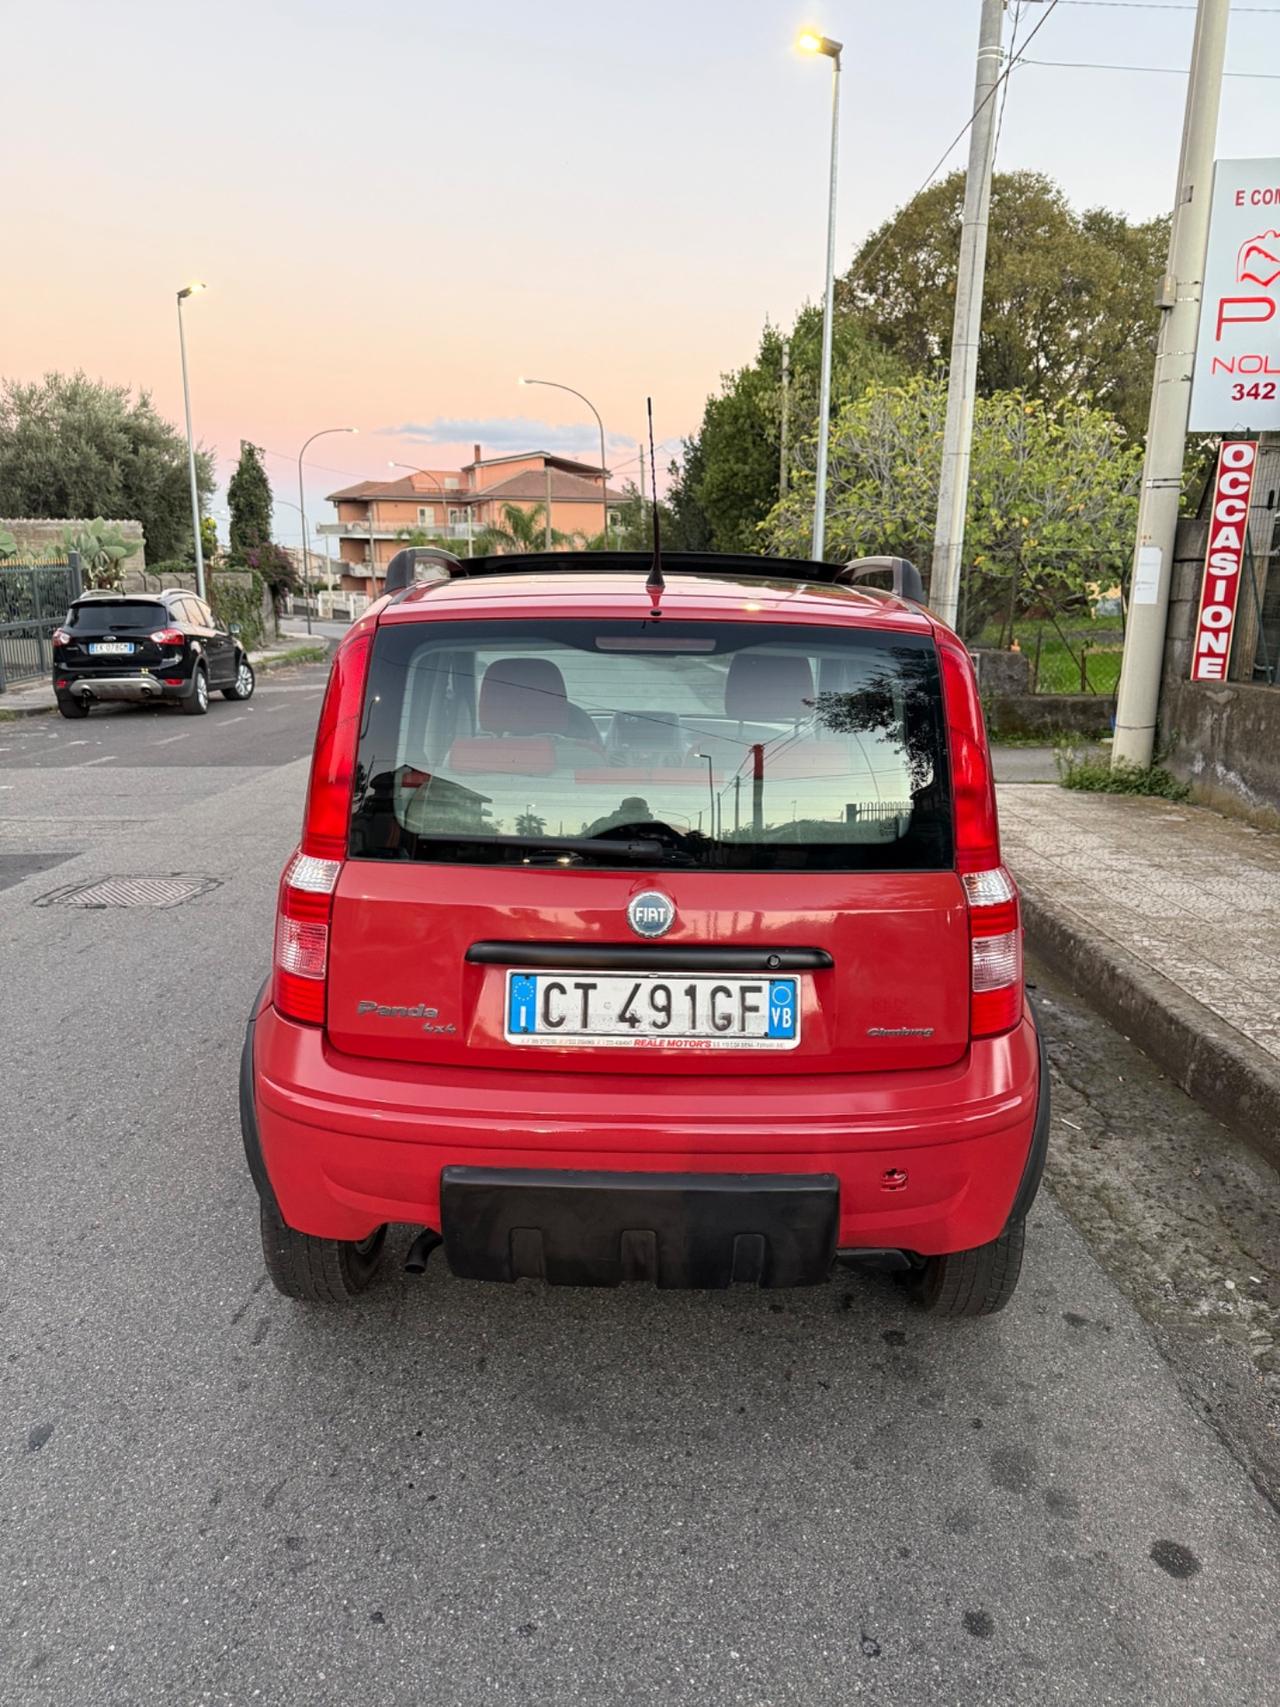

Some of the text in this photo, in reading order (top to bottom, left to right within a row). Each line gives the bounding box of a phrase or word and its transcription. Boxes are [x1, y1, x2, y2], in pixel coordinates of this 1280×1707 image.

[1235, 189, 1246, 206] E
[1215, 297, 1276, 342] P
[1231, 382, 1277, 401] 342
[1197, 443, 1254, 679] OCCASIONE
[635, 906, 666, 922] FIAT
[357, 1000, 438, 1019] Panda
[543, 982, 763, 1032] CT 491GF
[771, 1006, 792, 1029] VB
[422, 1022, 457, 1034] 4x4
[633, 1038, 665, 1048] REALE
